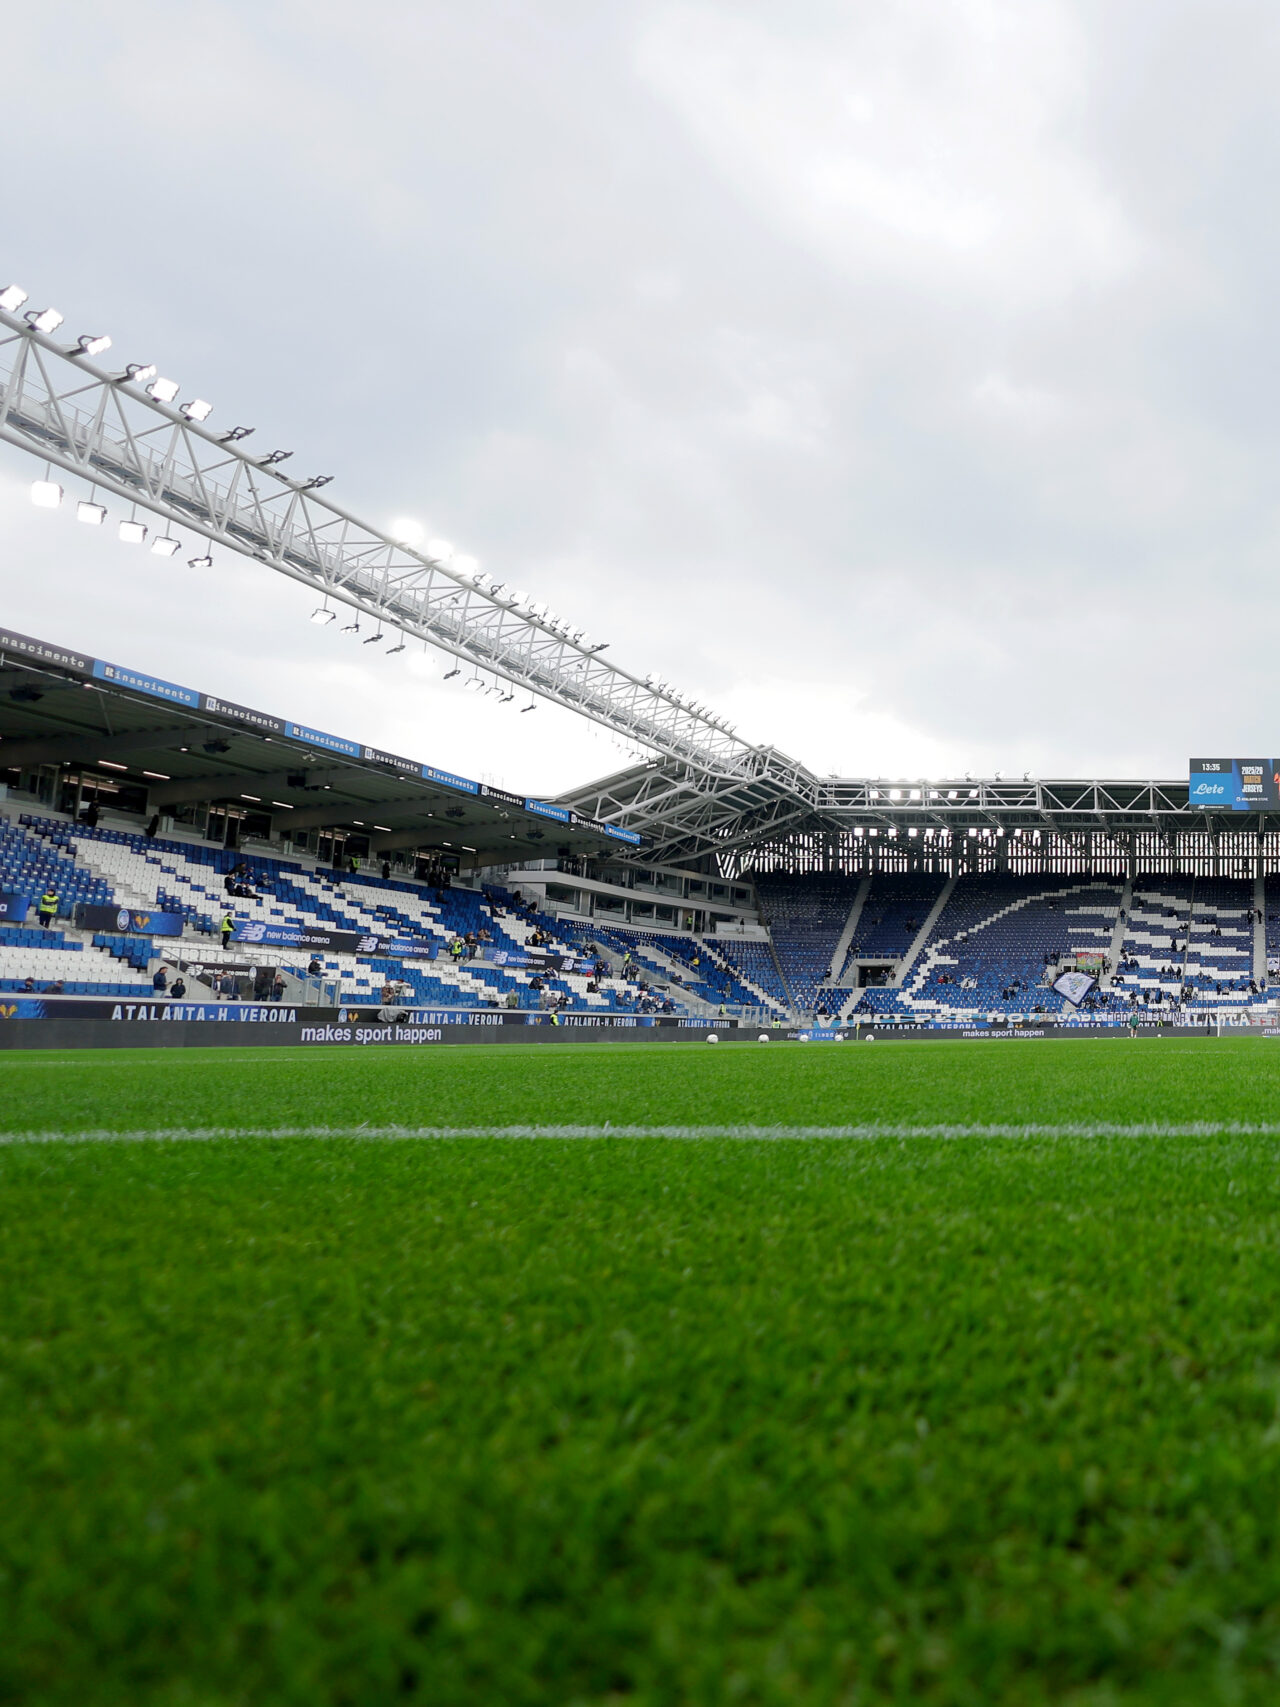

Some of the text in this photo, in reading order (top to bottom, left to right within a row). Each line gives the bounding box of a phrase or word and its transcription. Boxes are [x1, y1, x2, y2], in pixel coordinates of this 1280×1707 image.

[2, 636, 85, 668] nascimento
[104, 665, 191, 702] Rinascimento
[206, 697, 279, 730] Rinascimento
[292, 726, 354, 753] Rinascimento
[365, 747, 419, 773] Rinascimento
[1193, 783, 1225, 795] Lete
[267, 931, 281, 939] new
[282, 932, 310, 942] balance
[311, 936, 330, 944] arena
[390, 943, 413, 952] balance
[301, 1024, 442, 1044] makes sport happen
[963, 1029, 1044, 1038] makes sport happen
